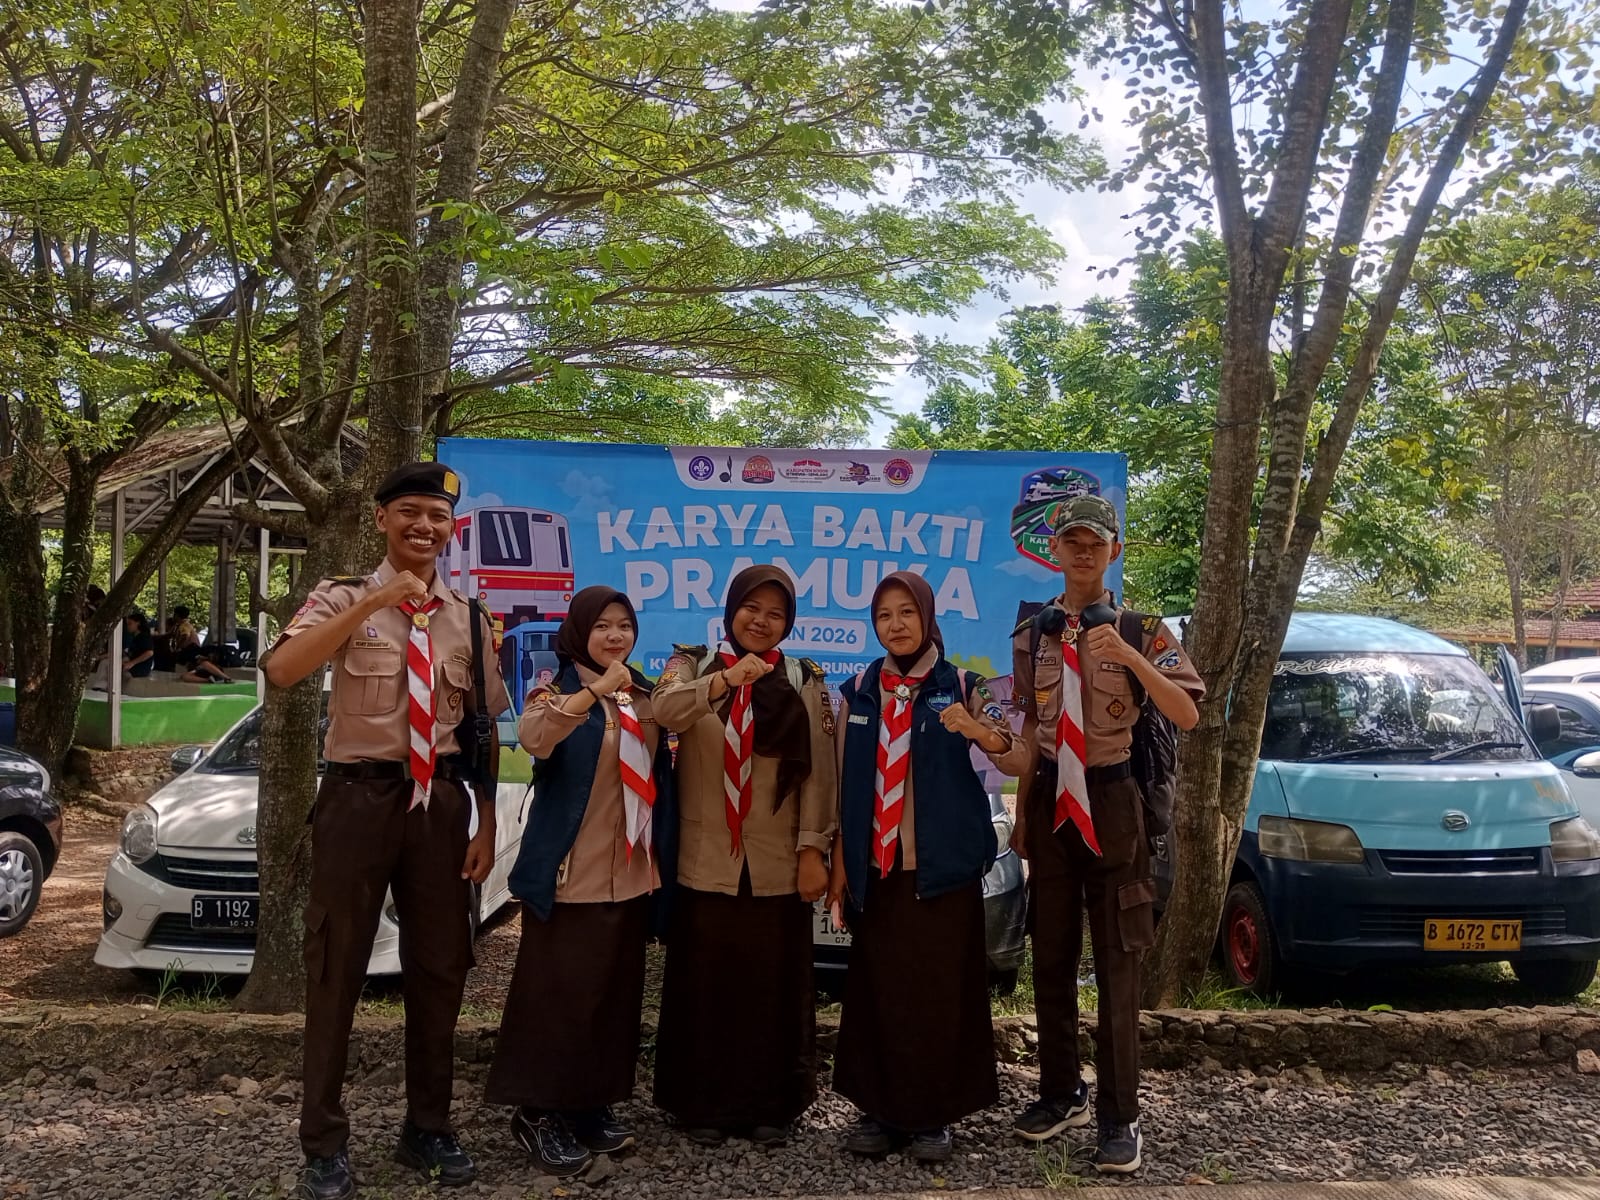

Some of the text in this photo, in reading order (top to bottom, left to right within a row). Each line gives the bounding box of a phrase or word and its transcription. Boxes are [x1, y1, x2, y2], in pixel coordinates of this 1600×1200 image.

[597, 504, 984, 562] KARYA BAKTI
[811, 626, 857, 644] 2026
[194, 900, 250, 918] B 1192
[1427, 923, 1519, 941] B 1672 CTX
